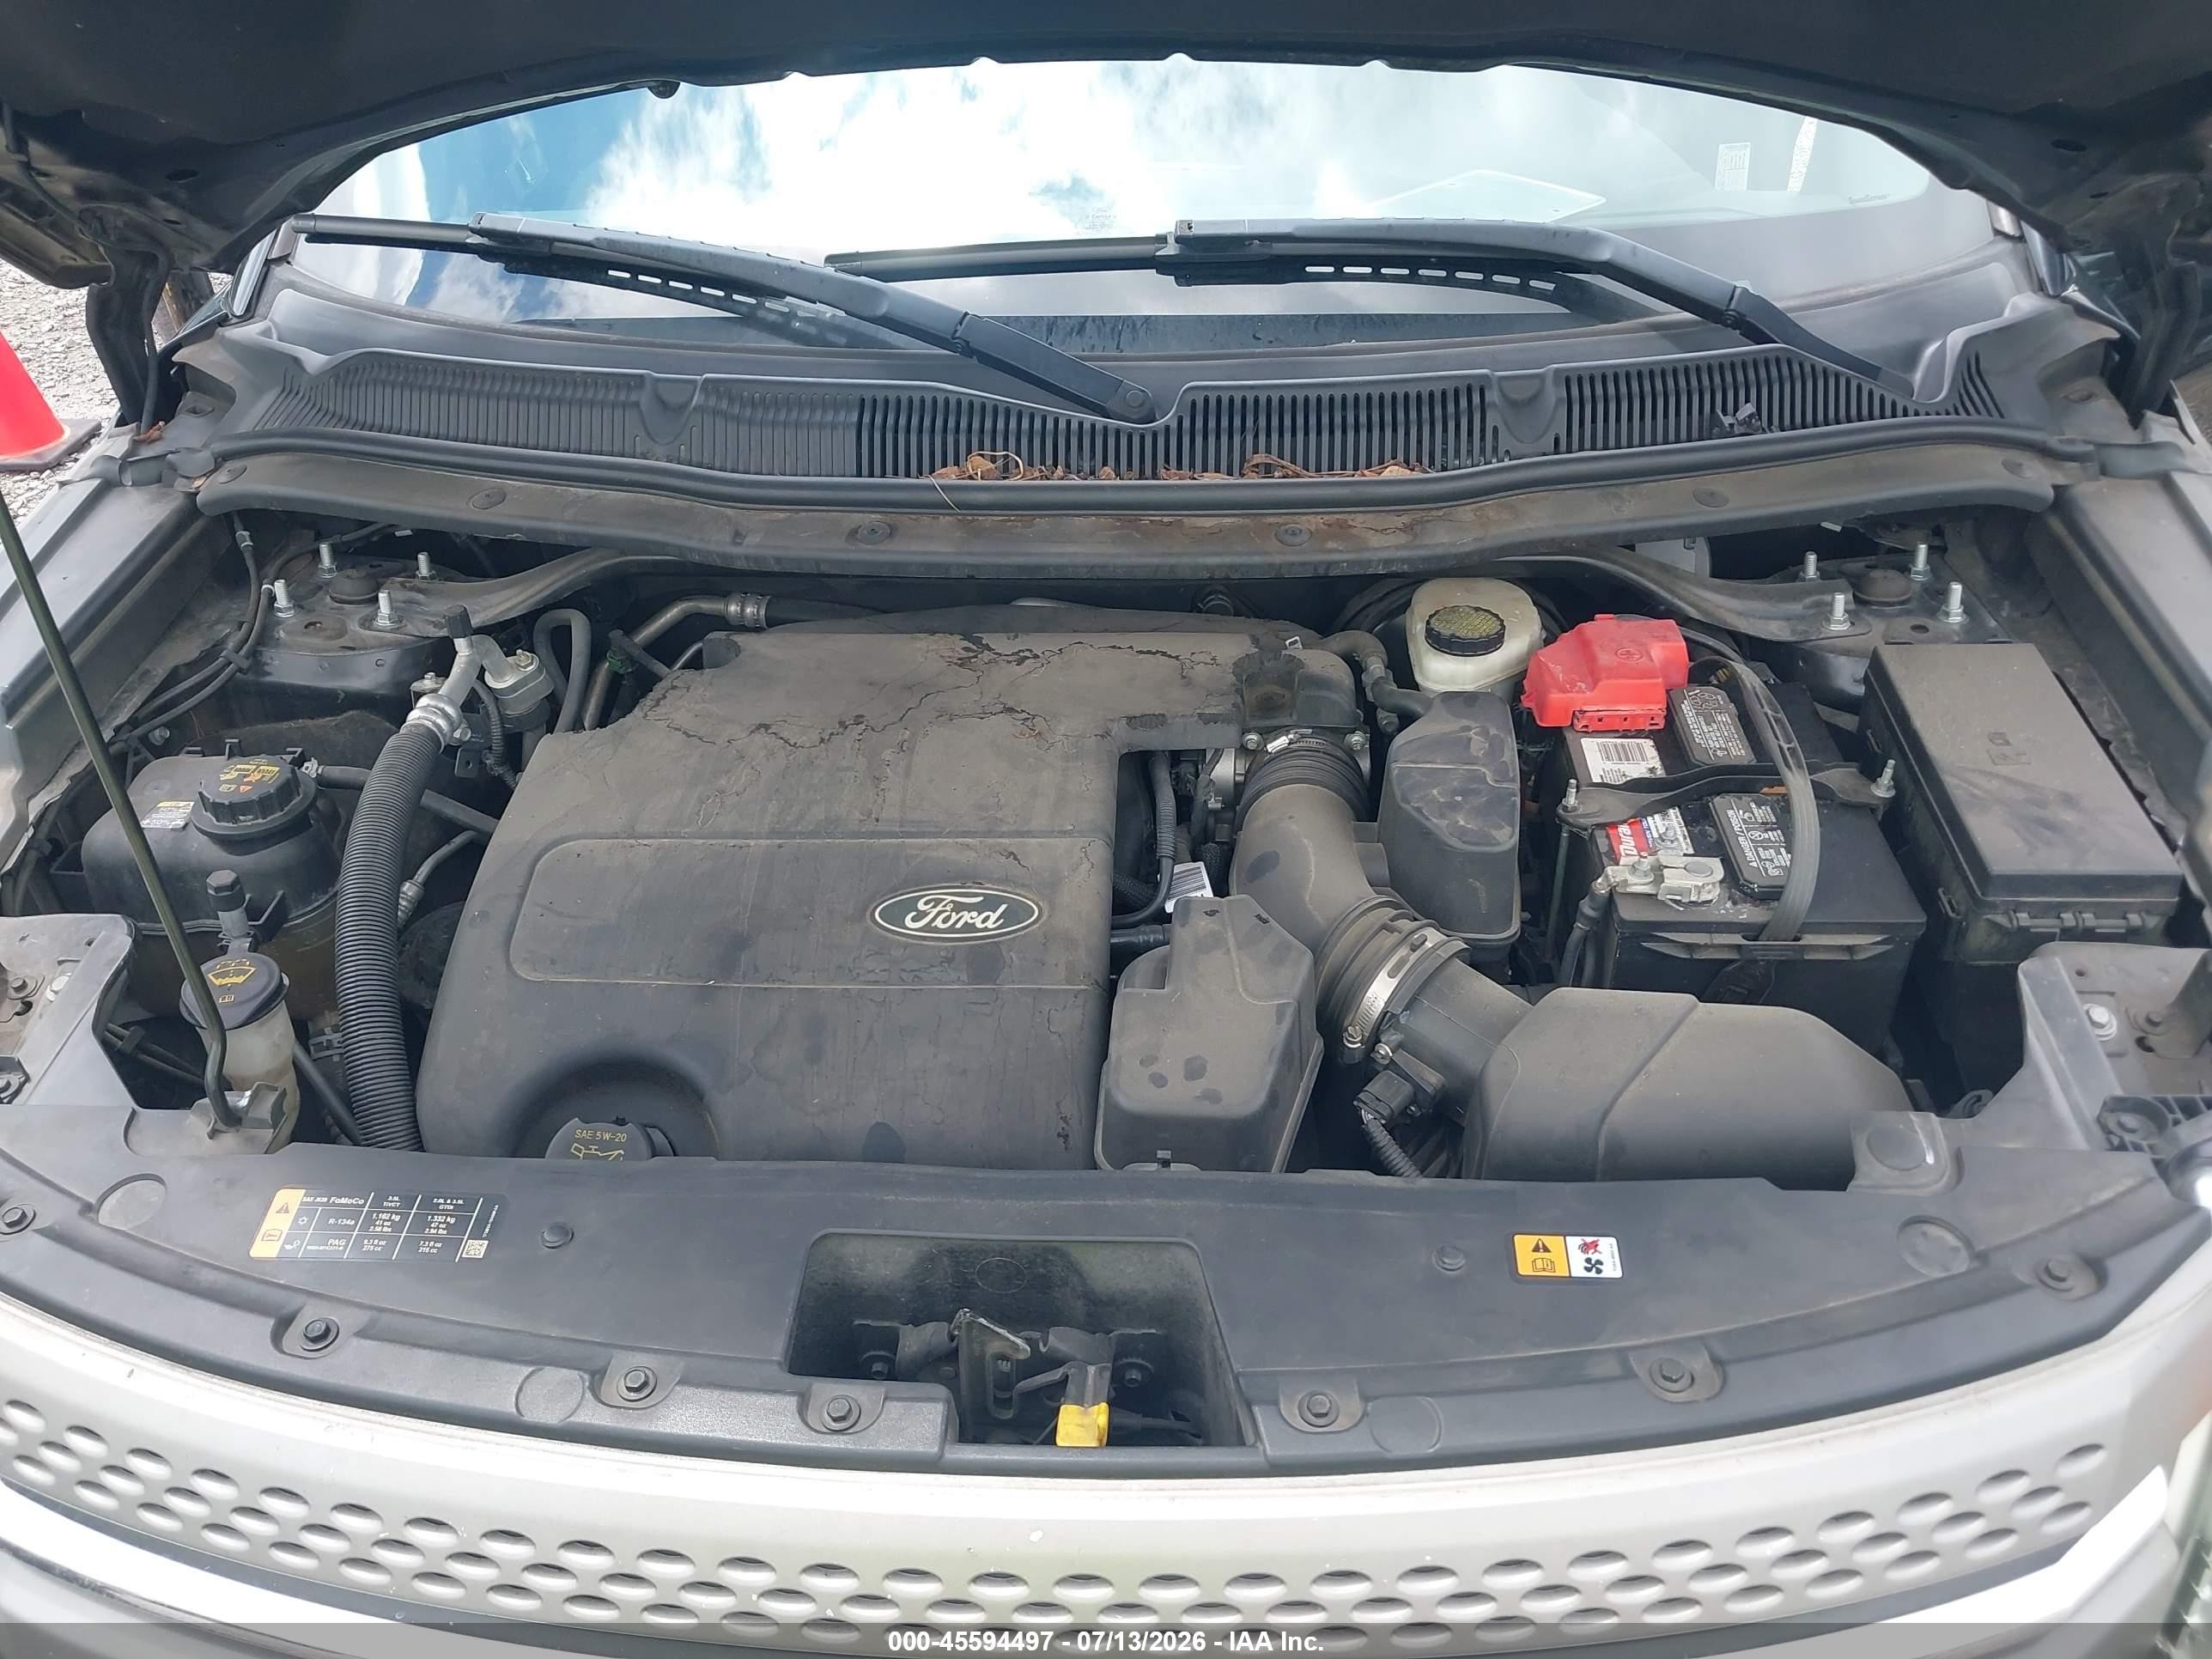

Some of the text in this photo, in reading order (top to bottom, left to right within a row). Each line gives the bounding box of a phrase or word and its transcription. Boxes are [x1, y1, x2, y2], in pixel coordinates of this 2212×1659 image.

[1725, 810, 1742, 831] POISON
[1738, 836, 1756, 860] DANGER
[904, 895, 1009, 929] Ford
[574, 1129, 628, 1142] SAE 5W-20
[329, 1196, 365, 1205] FoMoCo
